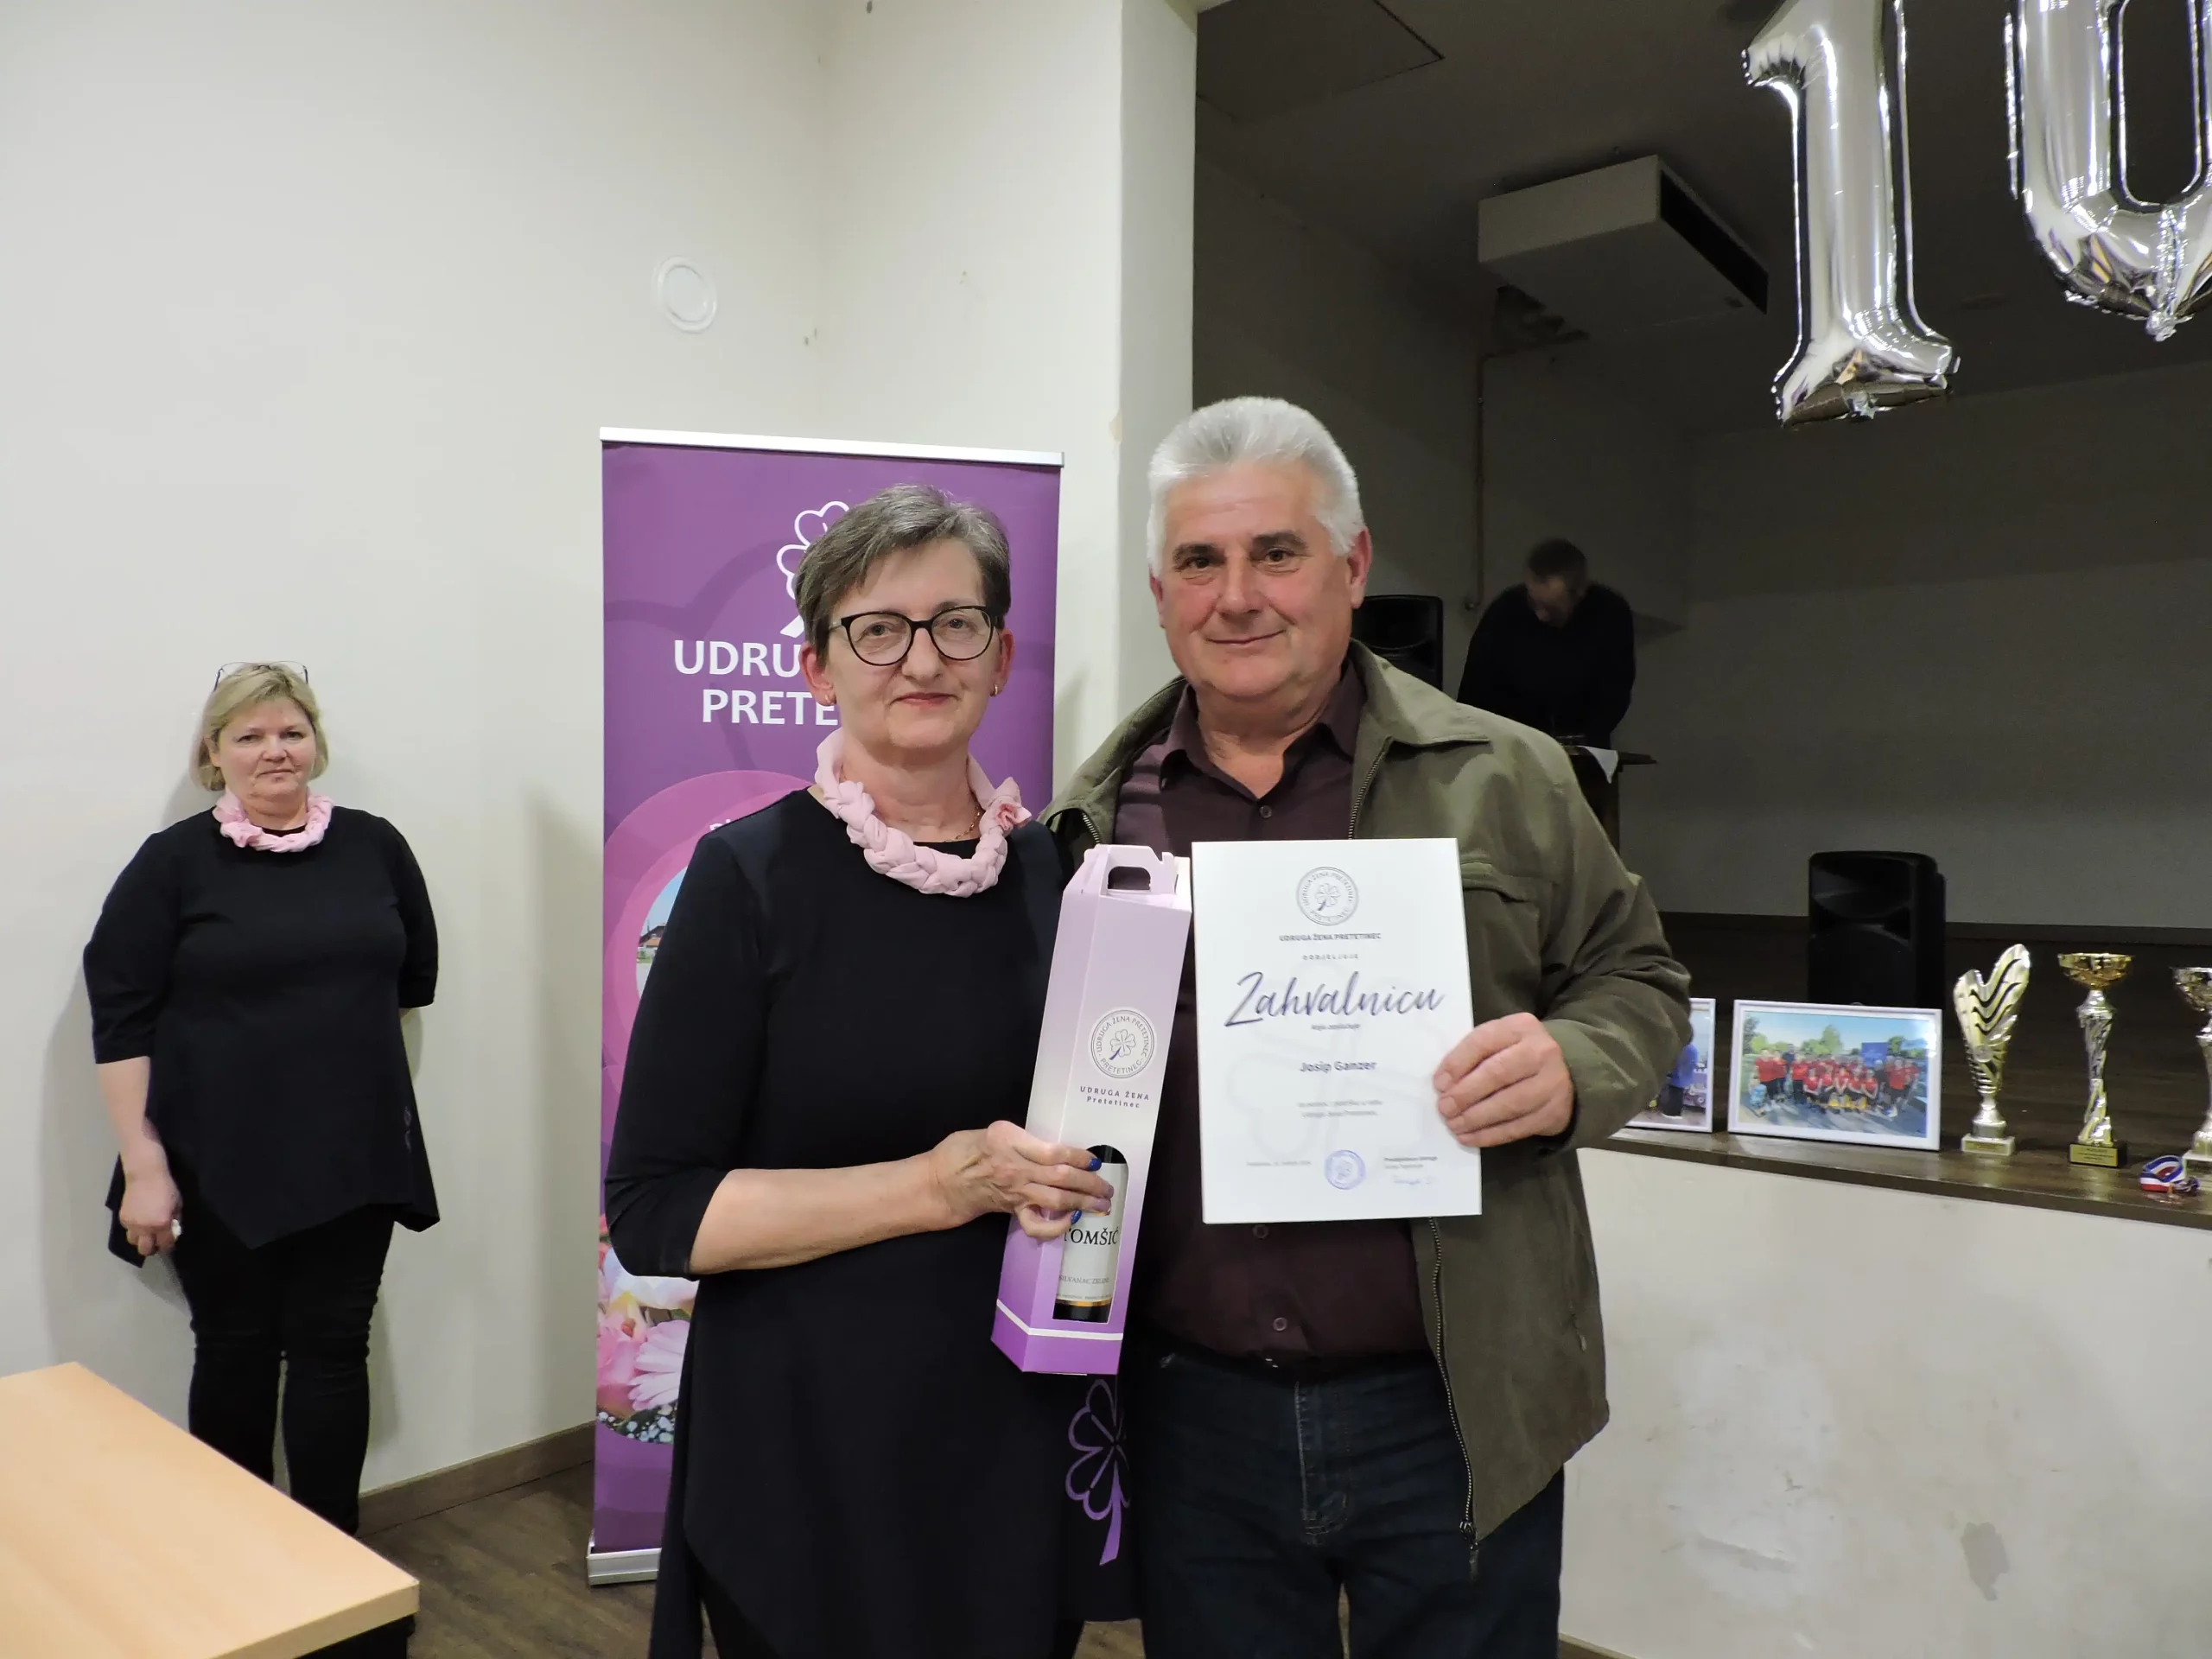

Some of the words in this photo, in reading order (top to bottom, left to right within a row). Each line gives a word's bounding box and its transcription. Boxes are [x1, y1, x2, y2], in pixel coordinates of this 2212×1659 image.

[1224, 970, 1445, 1027] Zahvalnicu
[1096, 1021, 1112, 1052] UDRUGA
[1300, 1061, 1332, 1073] Josip
[1080, 1085, 1120, 1096] UDRUGA
[1125, 1090, 1149, 1100] ŽENA
[1087, 1096, 1140, 1108] Pretetinec
